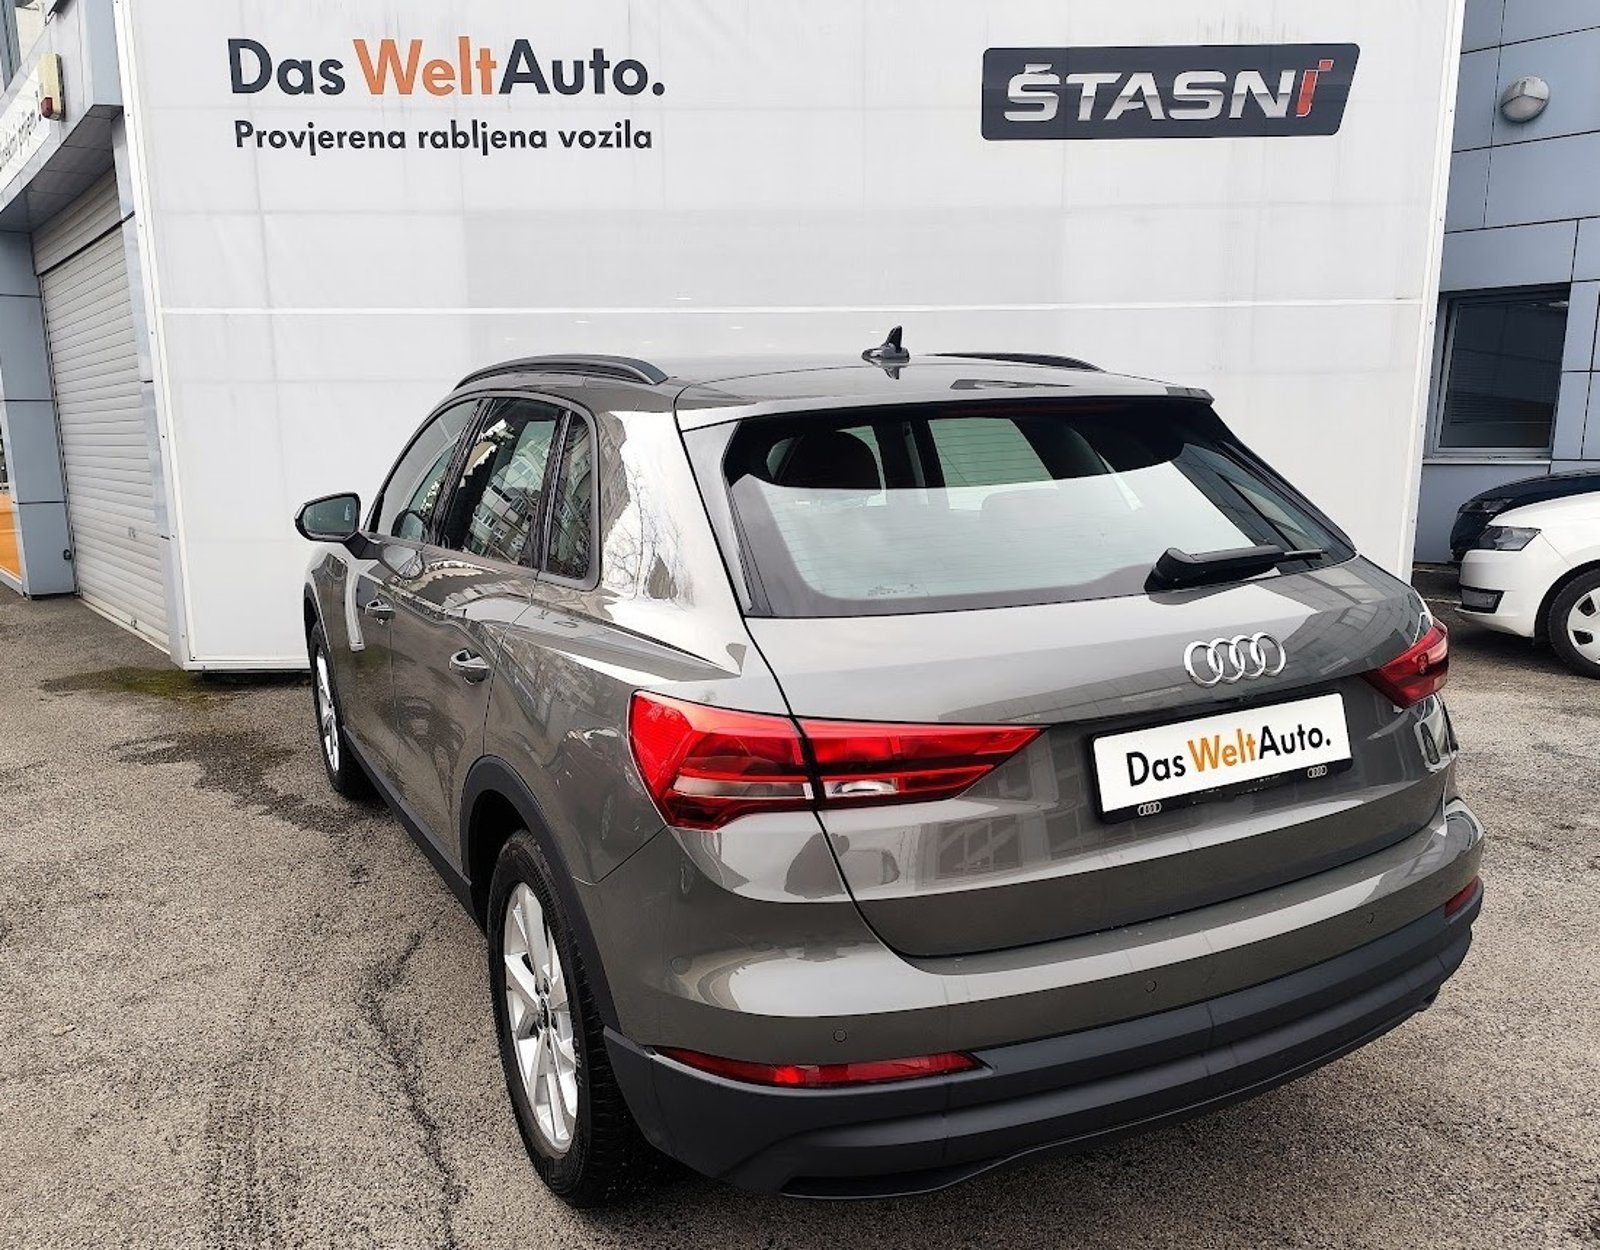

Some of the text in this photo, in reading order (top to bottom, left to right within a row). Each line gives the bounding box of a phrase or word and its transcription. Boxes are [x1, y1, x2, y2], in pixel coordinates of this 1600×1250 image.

[228, 36, 665, 96] Das WeltAuto.
[235, 119, 652, 156] Provjerena rabljena vozila
[1126, 723, 1332, 787] Das WeltAuto.
